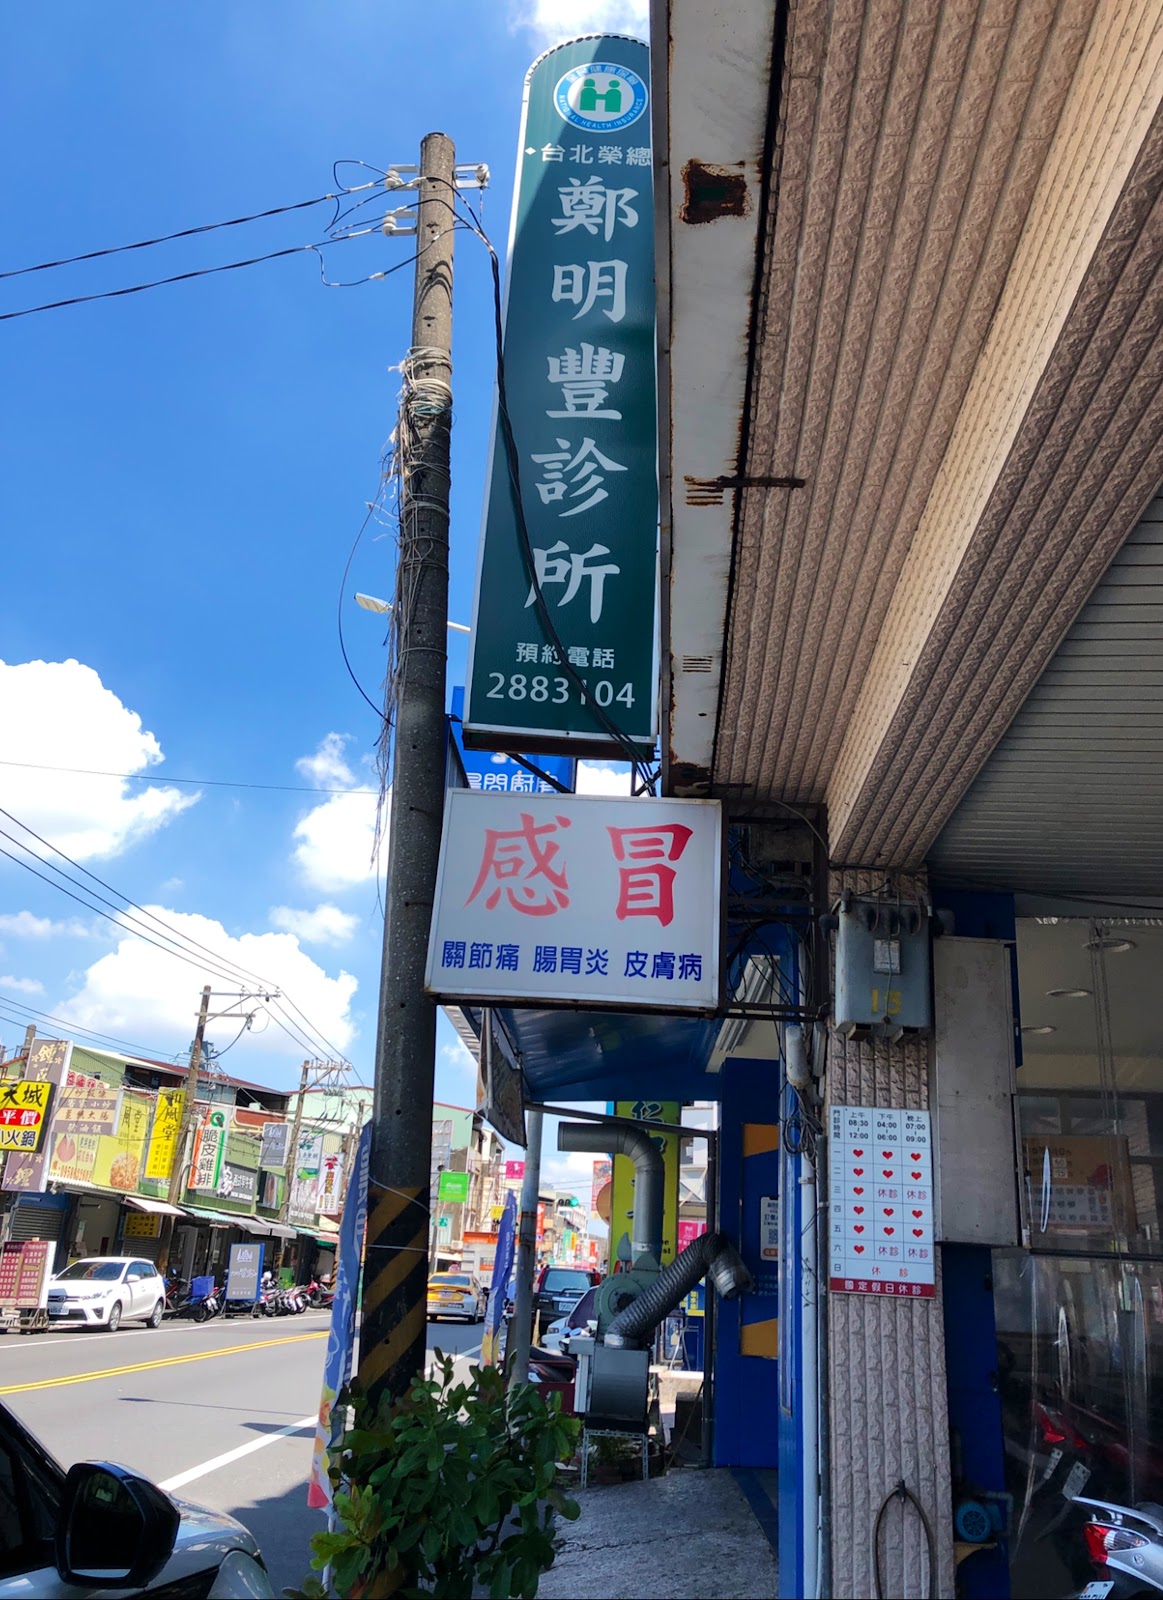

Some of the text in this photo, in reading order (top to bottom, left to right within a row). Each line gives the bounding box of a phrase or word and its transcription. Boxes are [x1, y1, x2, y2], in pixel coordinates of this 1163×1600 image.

[614, 98, 643, 127] INSURANCE
[541, 143, 651, 166] 台北榮總
[523, 175, 639, 624] 鄭明豐診所
[464, 812, 694, 927] 感冒
[441, 940, 703, 982] 關節痛 腸胃炎 皮膚病
[0, 1109, 38, 1126] 平價
[850, 1111, 865, 1119] 上午
[907, 1115, 922, 1123] 晚上
[833, 1109, 841, 1140] 門診時間
[848, 1119, 869, 1127] 08:30
[877, 1121, 897, 1129] 04:00
[905, 1123, 926, 1131] 07:00
[849, 1132, 869, 1140] 12:00
[877, 1134, 898, 1142] 06:00
[877, 1188, 898, 1198] 休診
[907, 1190, 928, 1200] 休診
[834, 1205, 842, 1213] 四
[834, 1225, 842, 1233] 五
[878, 1246, 899, 1256] 休診
[908, 1248, 929, 1259] 休診
[844, 1280, 922, 1295] 國定假日休診
